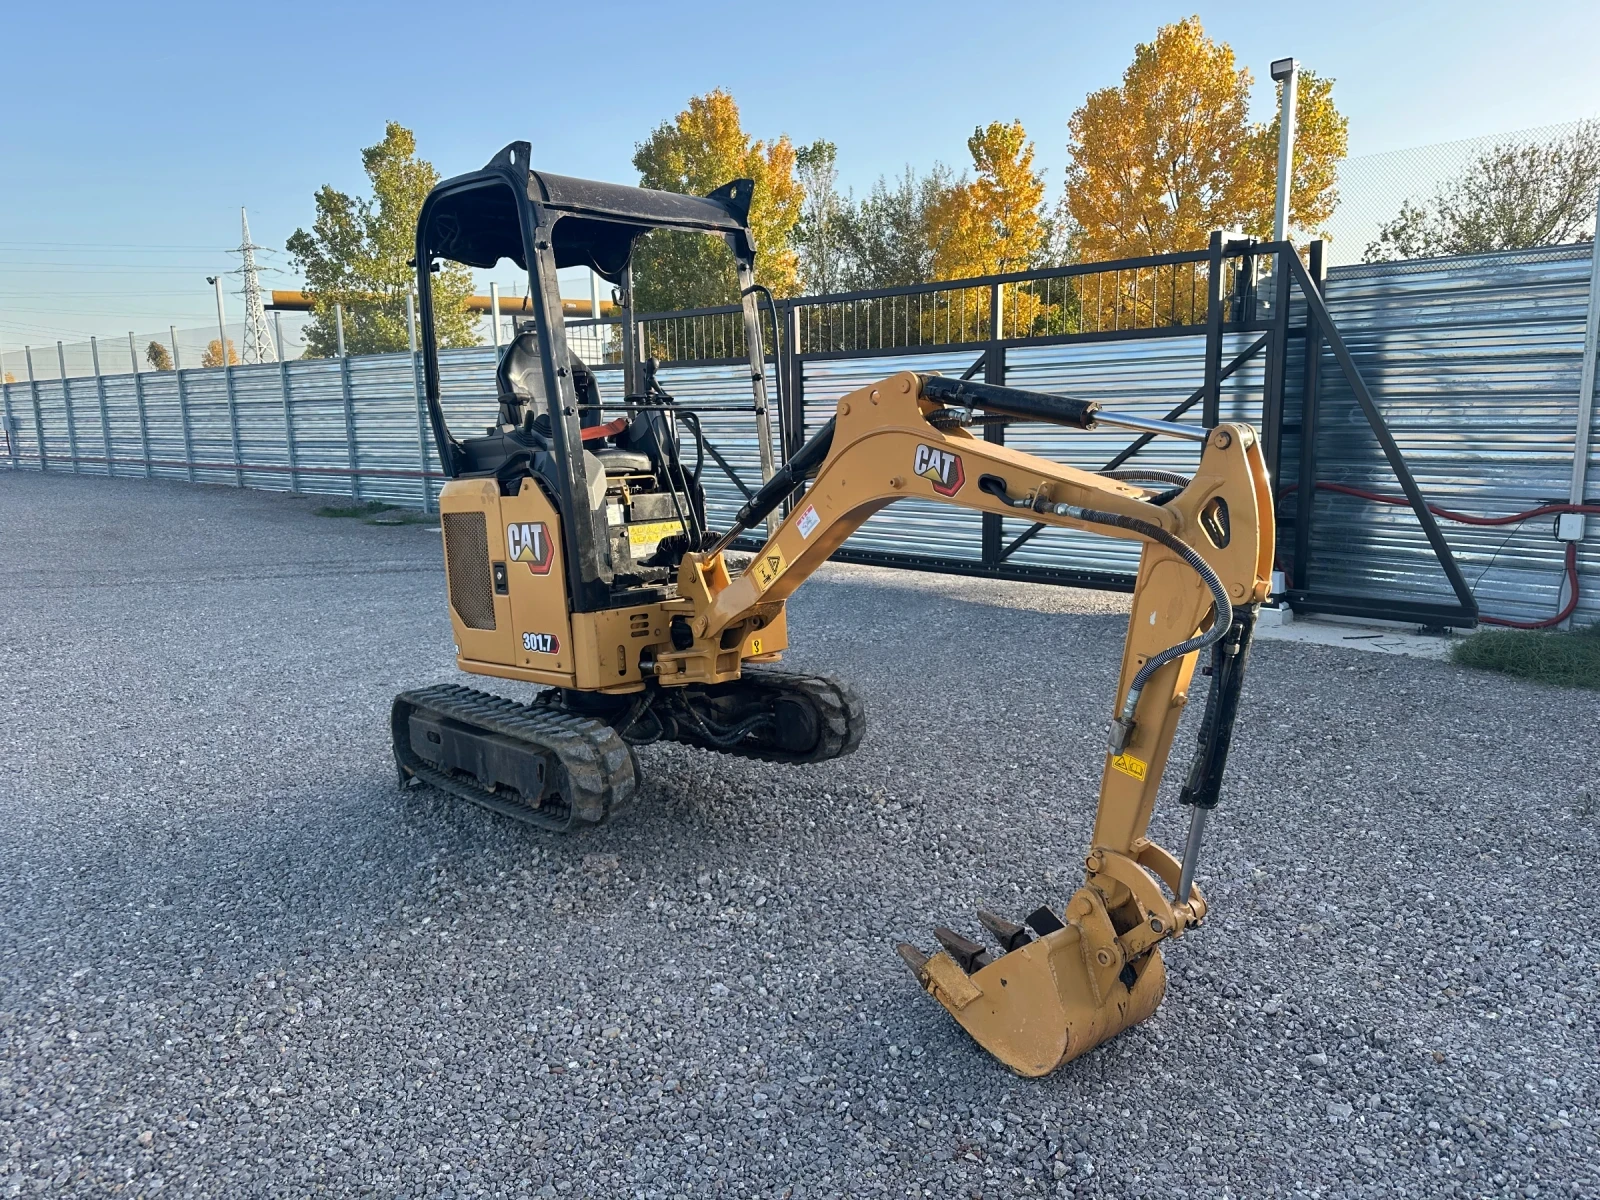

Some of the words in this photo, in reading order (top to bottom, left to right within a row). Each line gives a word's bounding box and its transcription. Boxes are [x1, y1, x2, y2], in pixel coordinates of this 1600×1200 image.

[914, 444, 956, 484] CAT
[507, 523, 542, 561] CAT
[522, 632, 552, 652] 301.7
